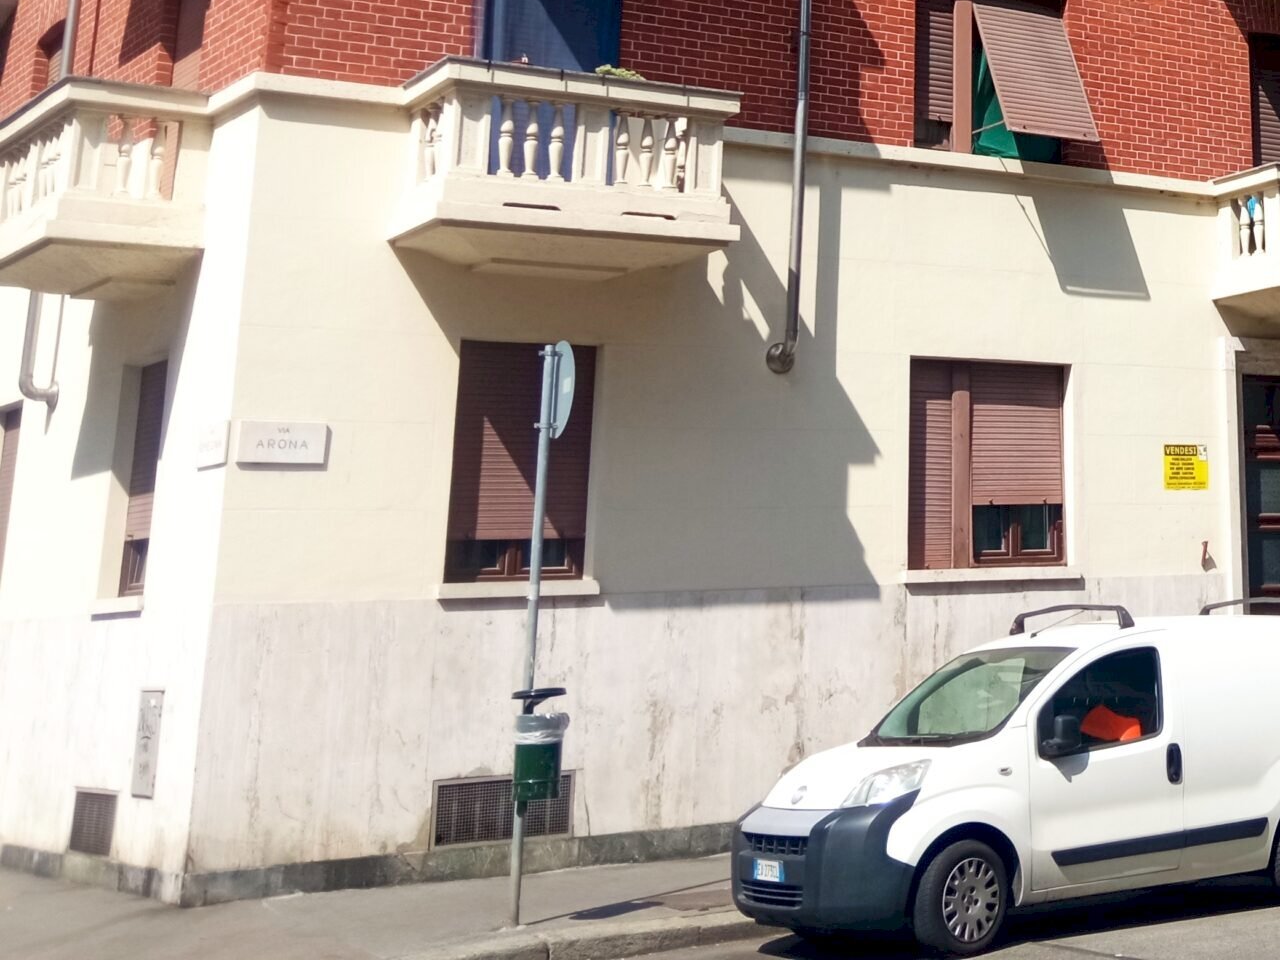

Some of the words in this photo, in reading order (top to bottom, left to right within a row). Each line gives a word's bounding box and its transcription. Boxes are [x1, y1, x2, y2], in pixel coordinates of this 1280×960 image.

[277, 426, 290, 434] VIA
[255, 438, 309, 450] ARONA
[1165, 445, 1197, 456] VENDESI
